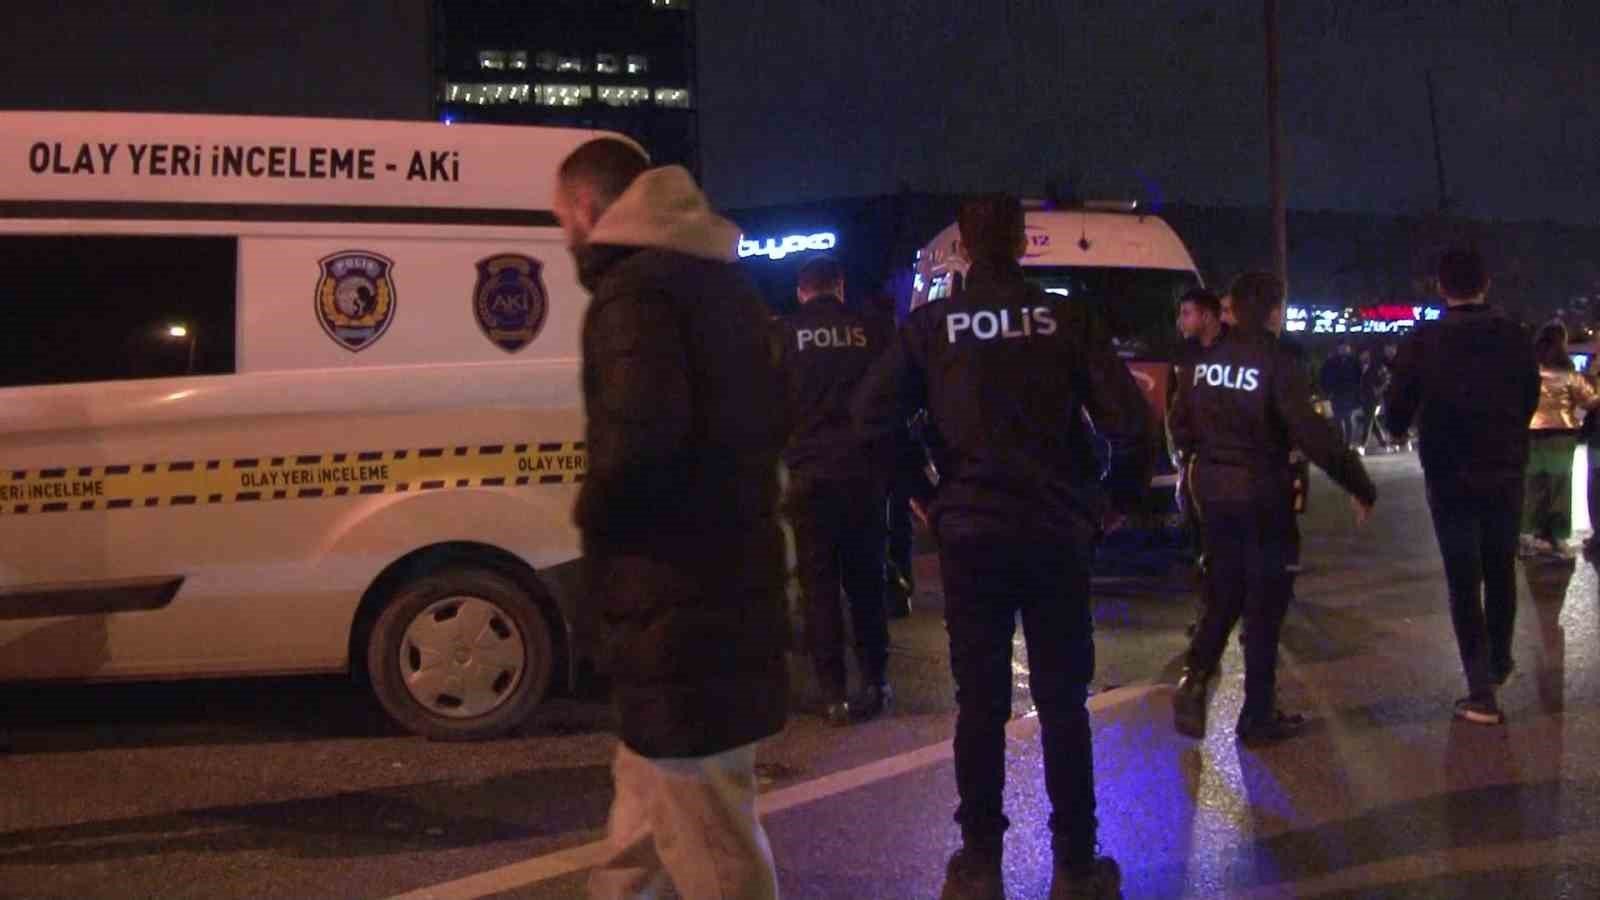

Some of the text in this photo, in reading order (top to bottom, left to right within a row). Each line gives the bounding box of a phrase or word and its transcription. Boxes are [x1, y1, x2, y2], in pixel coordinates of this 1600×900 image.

[29, 141, 118, 174] OLAY
[518, 456, 553, 471] OLAY
[240, 470, 278, 486] OLAY
